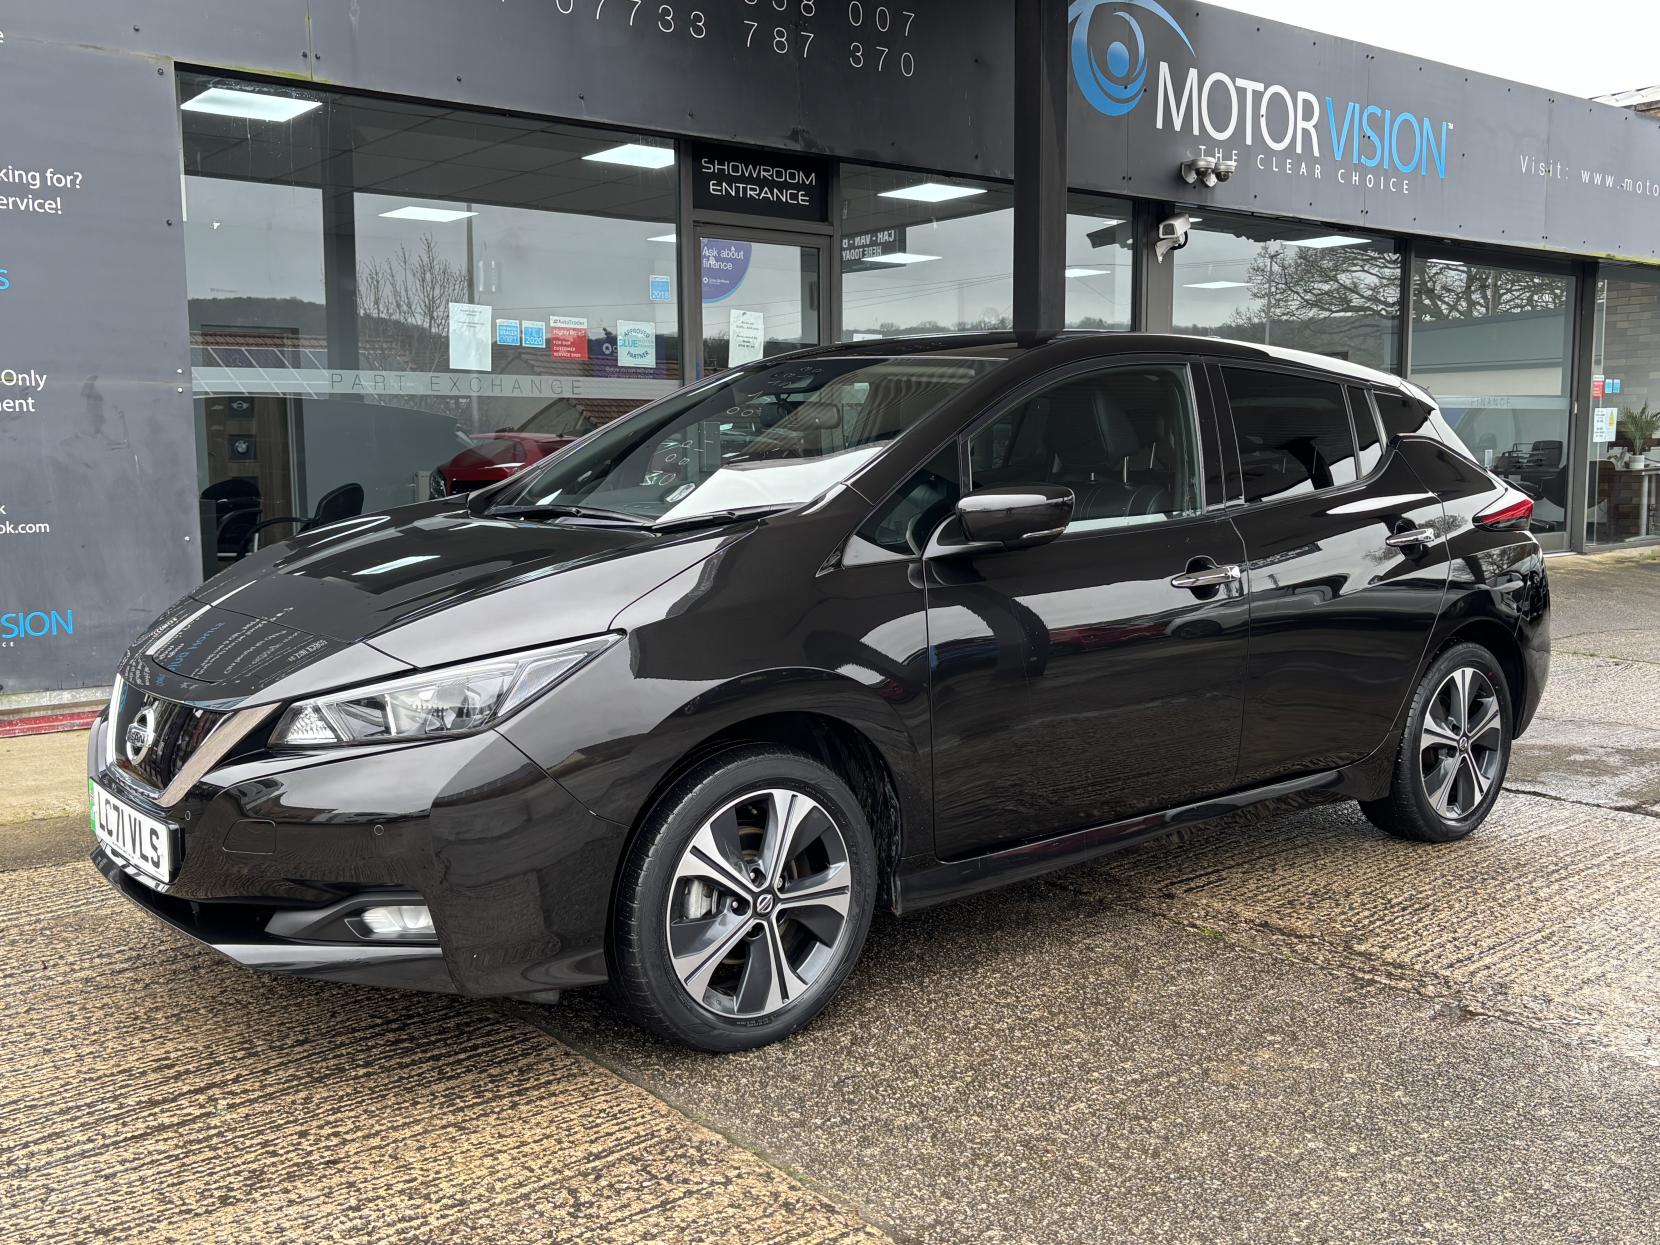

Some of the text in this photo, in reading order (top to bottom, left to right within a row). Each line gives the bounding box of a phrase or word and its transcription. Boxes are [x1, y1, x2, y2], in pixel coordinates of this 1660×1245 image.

[848, 1, 914, 37] 007
[743, 20, 815, 58] 787
[849, 42, 914, 77] 370
[701, 158, 816, 186] SHOWROOM
[1257, 154, 1321, 179] CLEAR
[1337, 170, 1409, 194] CHOICE
[1520, 154, 1569, 180] Visit:
[45, 168, 83, 189] for?
[709, 180, 810, 206] ENTRANCE
[702, 245, 744, 260] Ask about
[703, 258, 733, 270] finance
[623, 327, 651, 339] APPROVED
[626, 350, 650, 360] PARTNER
[1, 369, 47, 391] Only
[331, 373, 583, 396] PART EXCHANGE
[0, 396, 36, 412] ent
